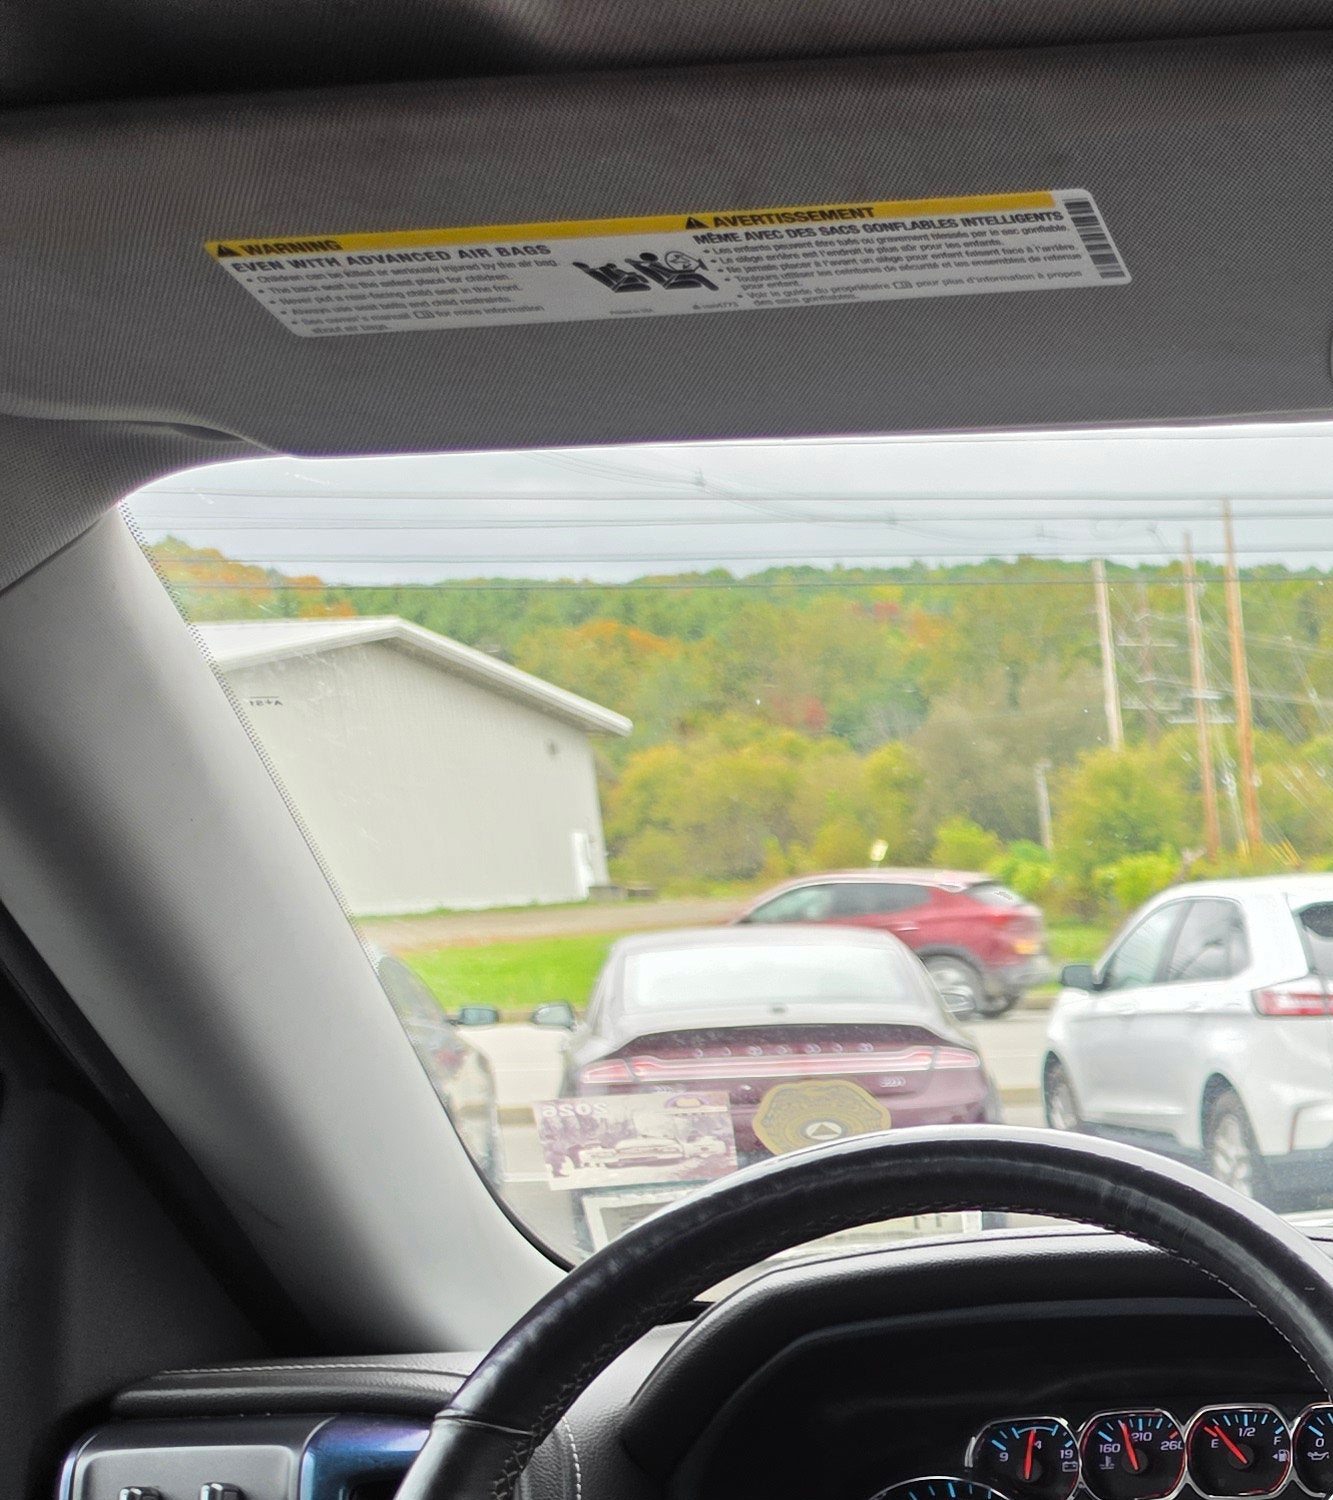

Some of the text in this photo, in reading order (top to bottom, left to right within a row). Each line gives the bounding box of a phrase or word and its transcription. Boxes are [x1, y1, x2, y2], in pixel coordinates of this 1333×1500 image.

[713, 207, 875, 228] AVERTISSEMENT
[693, 211, 1064, 244] MÊME AVEC DES SACS GONFLABLES INTELLIGENTS
[239, 240, 342, 255] WARNING
[232, 245, 551, 272] EVEN WITH ADVANCED AIR BAGS
[257, 272, 303, 283] Children
[481, 262, 495, 271] by
[498, 260, 516, 269] the
[518, 259, 531, 268] air
[1237, 1427, 1255, 1438] 1/2
[1210, 1439, 1220, 1449] E
[1273, 1436, 1282, 1445] F
[1099, 1443, 1120, 1453] 160
[999, 1451, 1009, 1462] 9
[1059, 1449, 1074, 1460] 19
